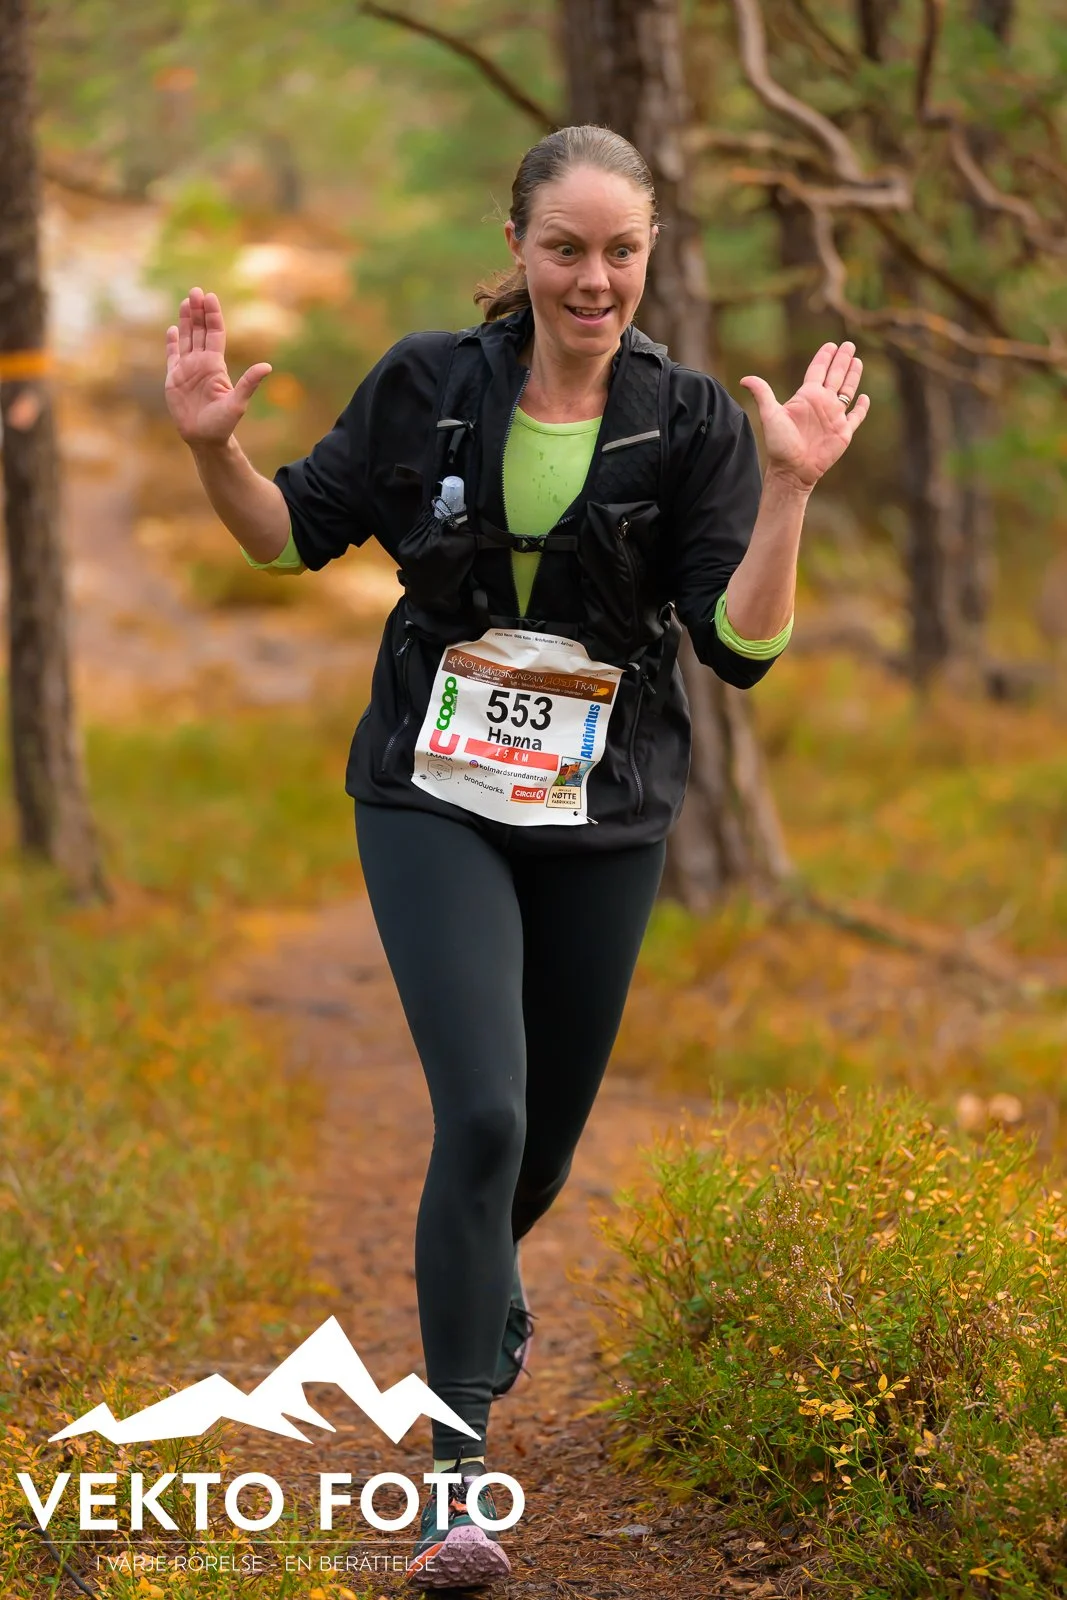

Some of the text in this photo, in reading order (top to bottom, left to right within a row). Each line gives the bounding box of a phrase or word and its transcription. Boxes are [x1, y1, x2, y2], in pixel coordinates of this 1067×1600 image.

[436, 676, 459, 731] coop
[486, 689, 553, 730] 553
[487, 727, 542, 751] Hanna
[580, 703, 600, 759] Aktivitus
[515, 790, 536, 798] CIRCLE
[551, 792, 577, 800] NØTTE
